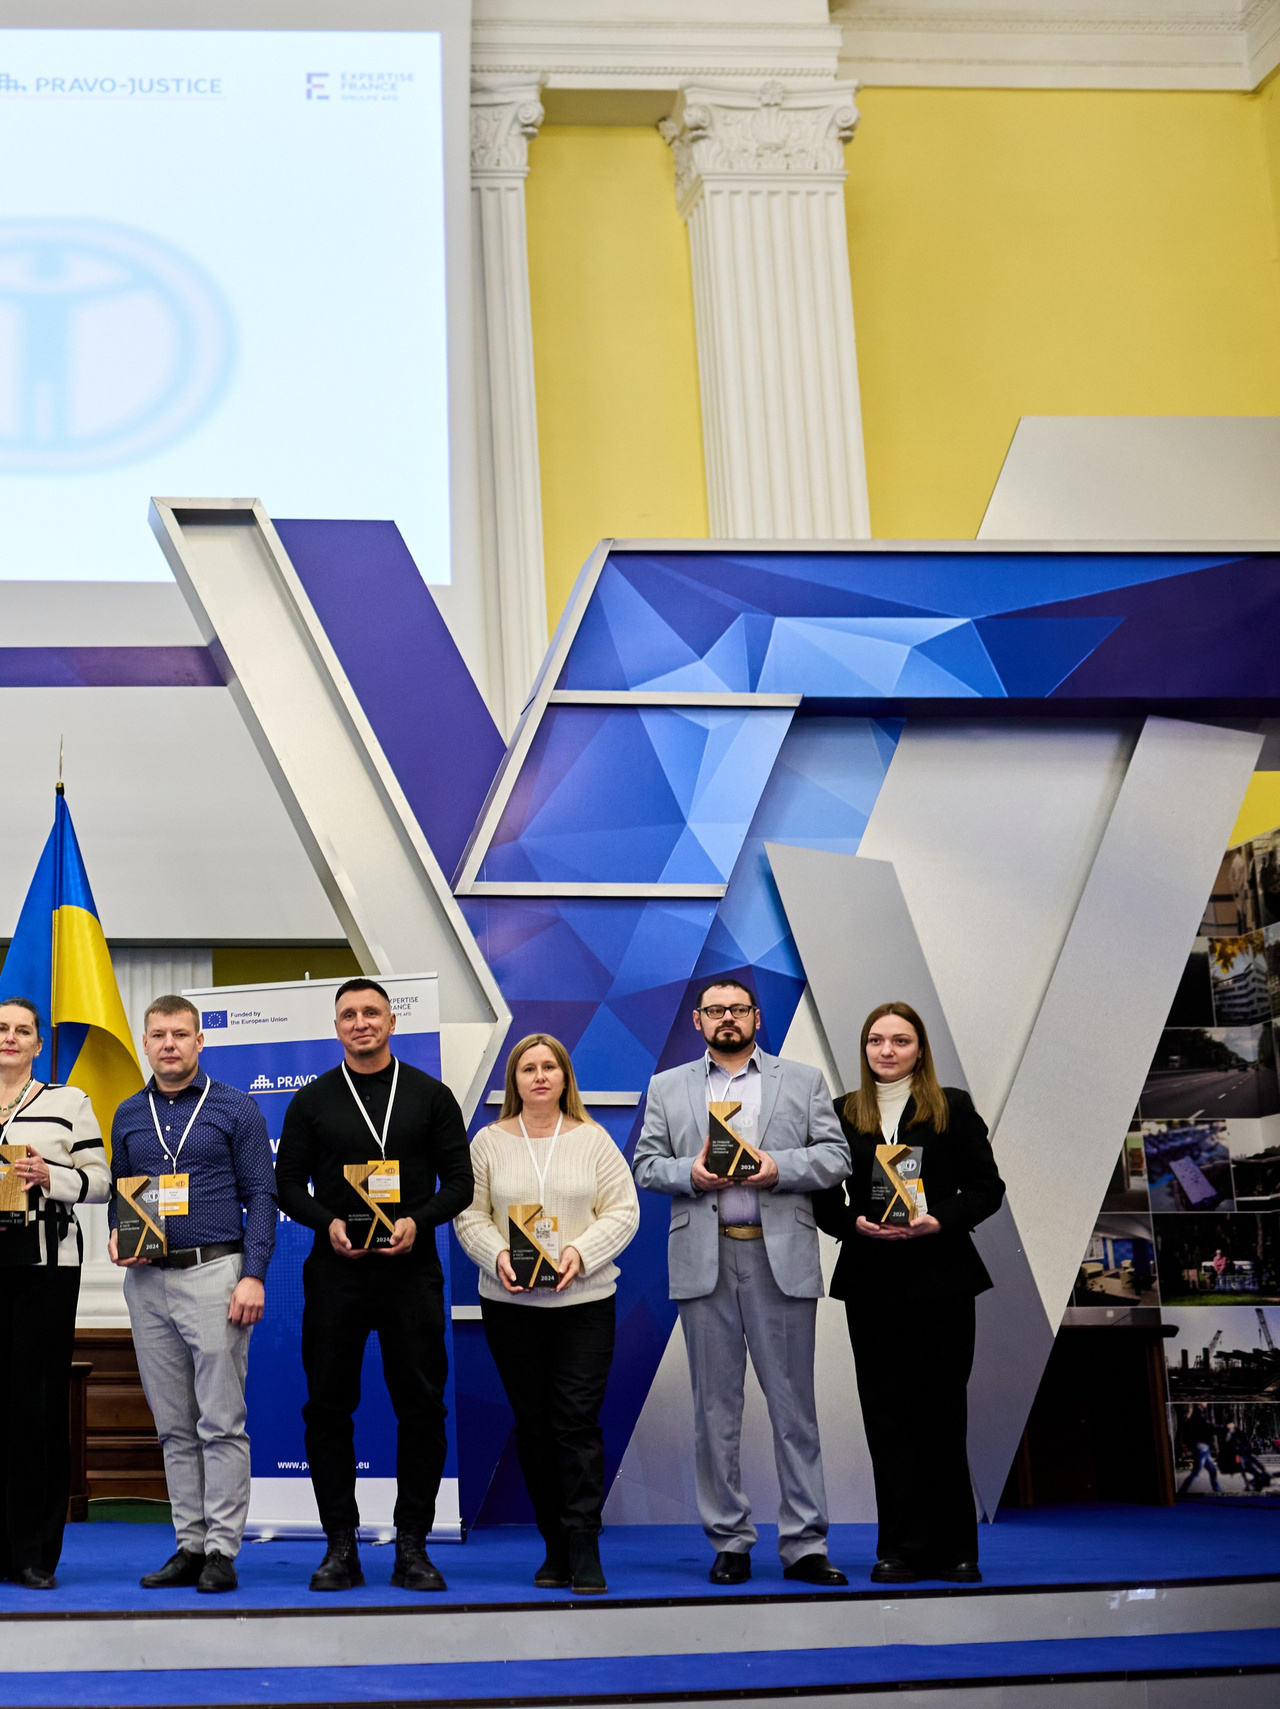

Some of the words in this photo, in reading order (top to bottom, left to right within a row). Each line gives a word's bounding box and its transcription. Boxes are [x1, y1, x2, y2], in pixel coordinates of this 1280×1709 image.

[340, 71, 415, 82] EXPERTISE
[35, 76, 223, 95] PRAVO-JUSTICE
[340, 82, 398, 92] FRANCE
[390, 996, 419, 1004] XPERTISE
[391, 1003, 412, 1011] ANCE
[241, 1017, 269, 1025] European
